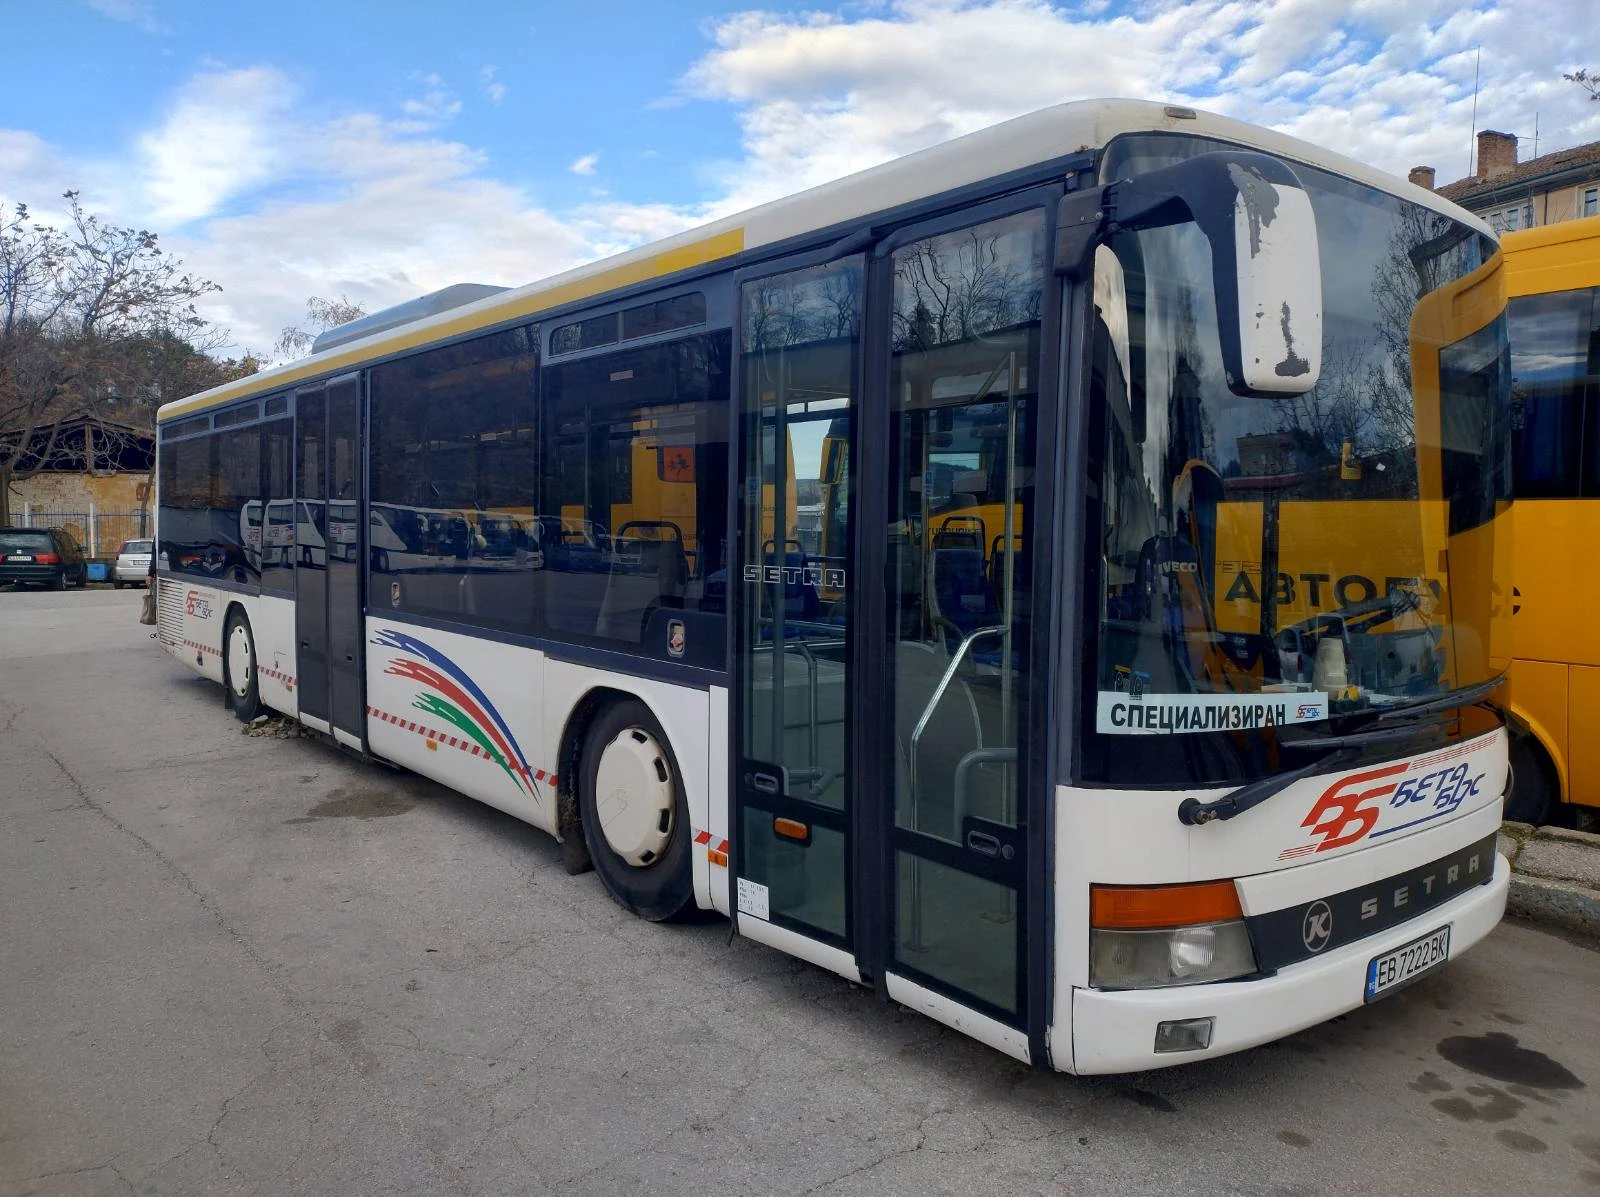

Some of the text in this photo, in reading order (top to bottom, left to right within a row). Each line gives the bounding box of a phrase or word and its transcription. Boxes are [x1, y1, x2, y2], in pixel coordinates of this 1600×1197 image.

[743, 564, 846, 588] SETRA
[1110, 703, 1286, 734] СПЕЦИАЛИЗИРАН
[1361, 854, 1480, 920] SETRA
